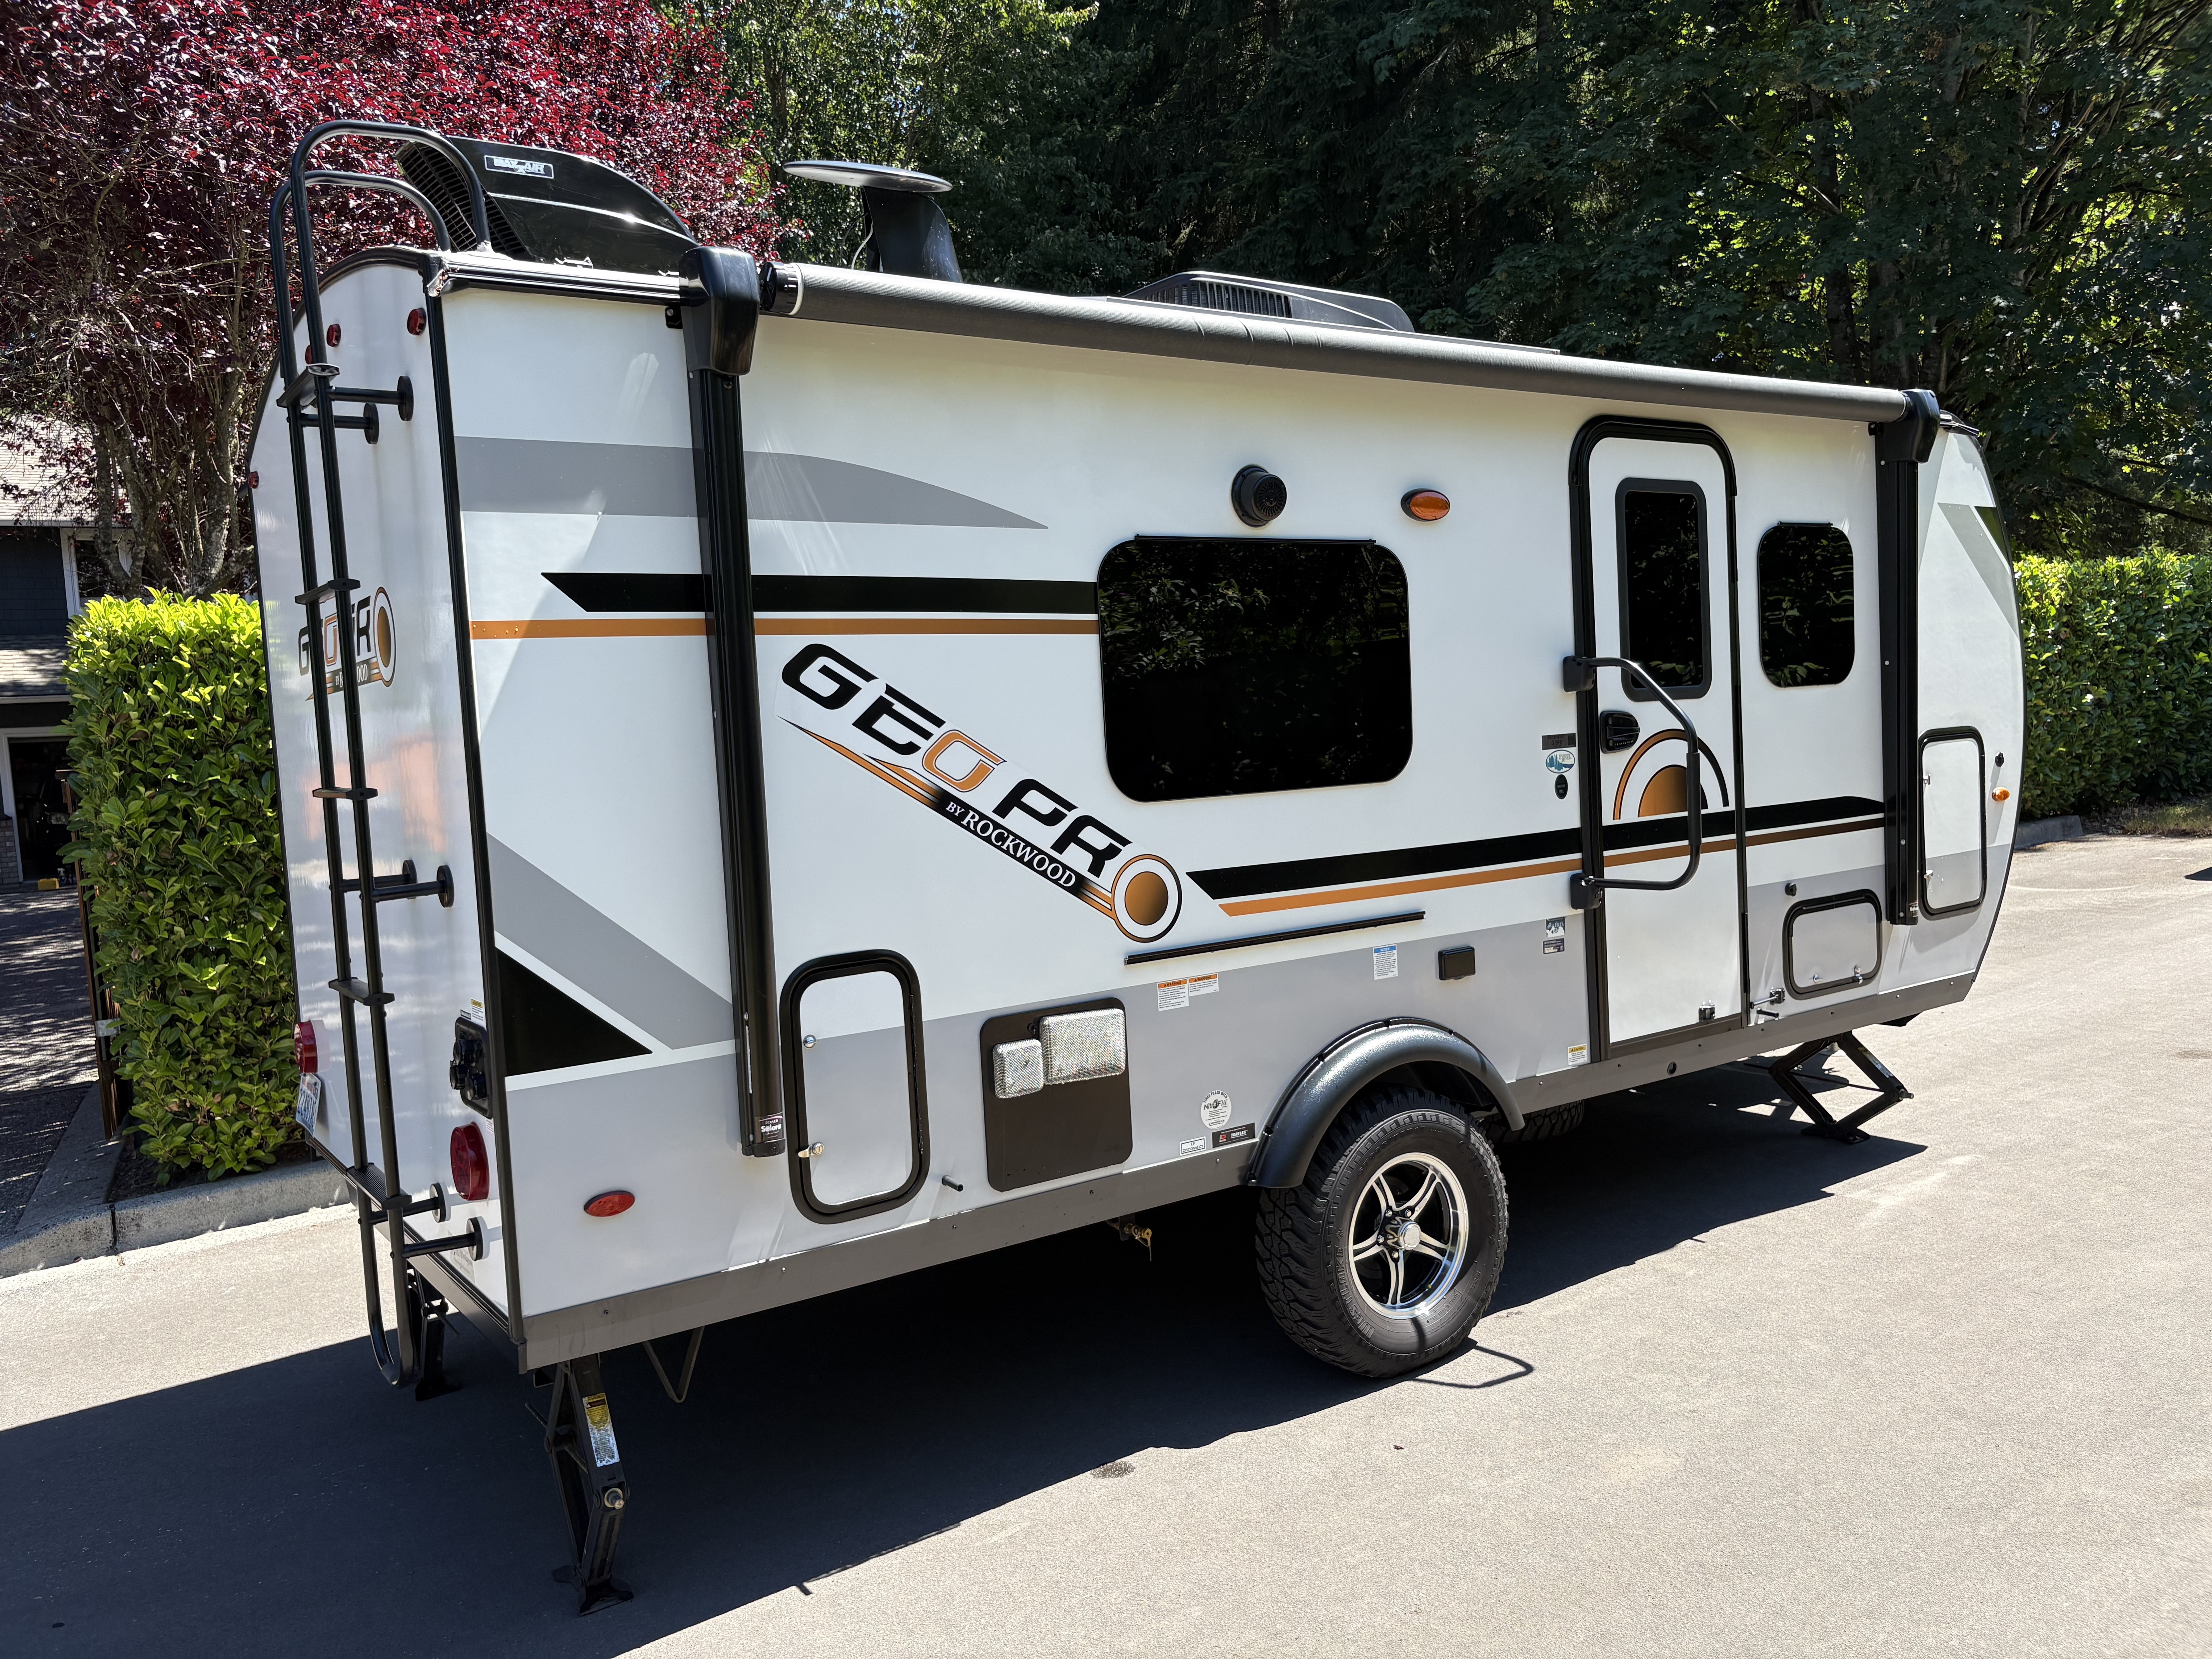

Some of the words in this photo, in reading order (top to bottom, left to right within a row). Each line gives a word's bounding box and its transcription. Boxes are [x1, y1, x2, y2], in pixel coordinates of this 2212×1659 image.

[782, 643, 1006, 792] GEO
[945, 801, 965, 817] BY
[961, 810, 1076, 888] ROCKWOOD
[761, 1123, 782, 1132] Solera
